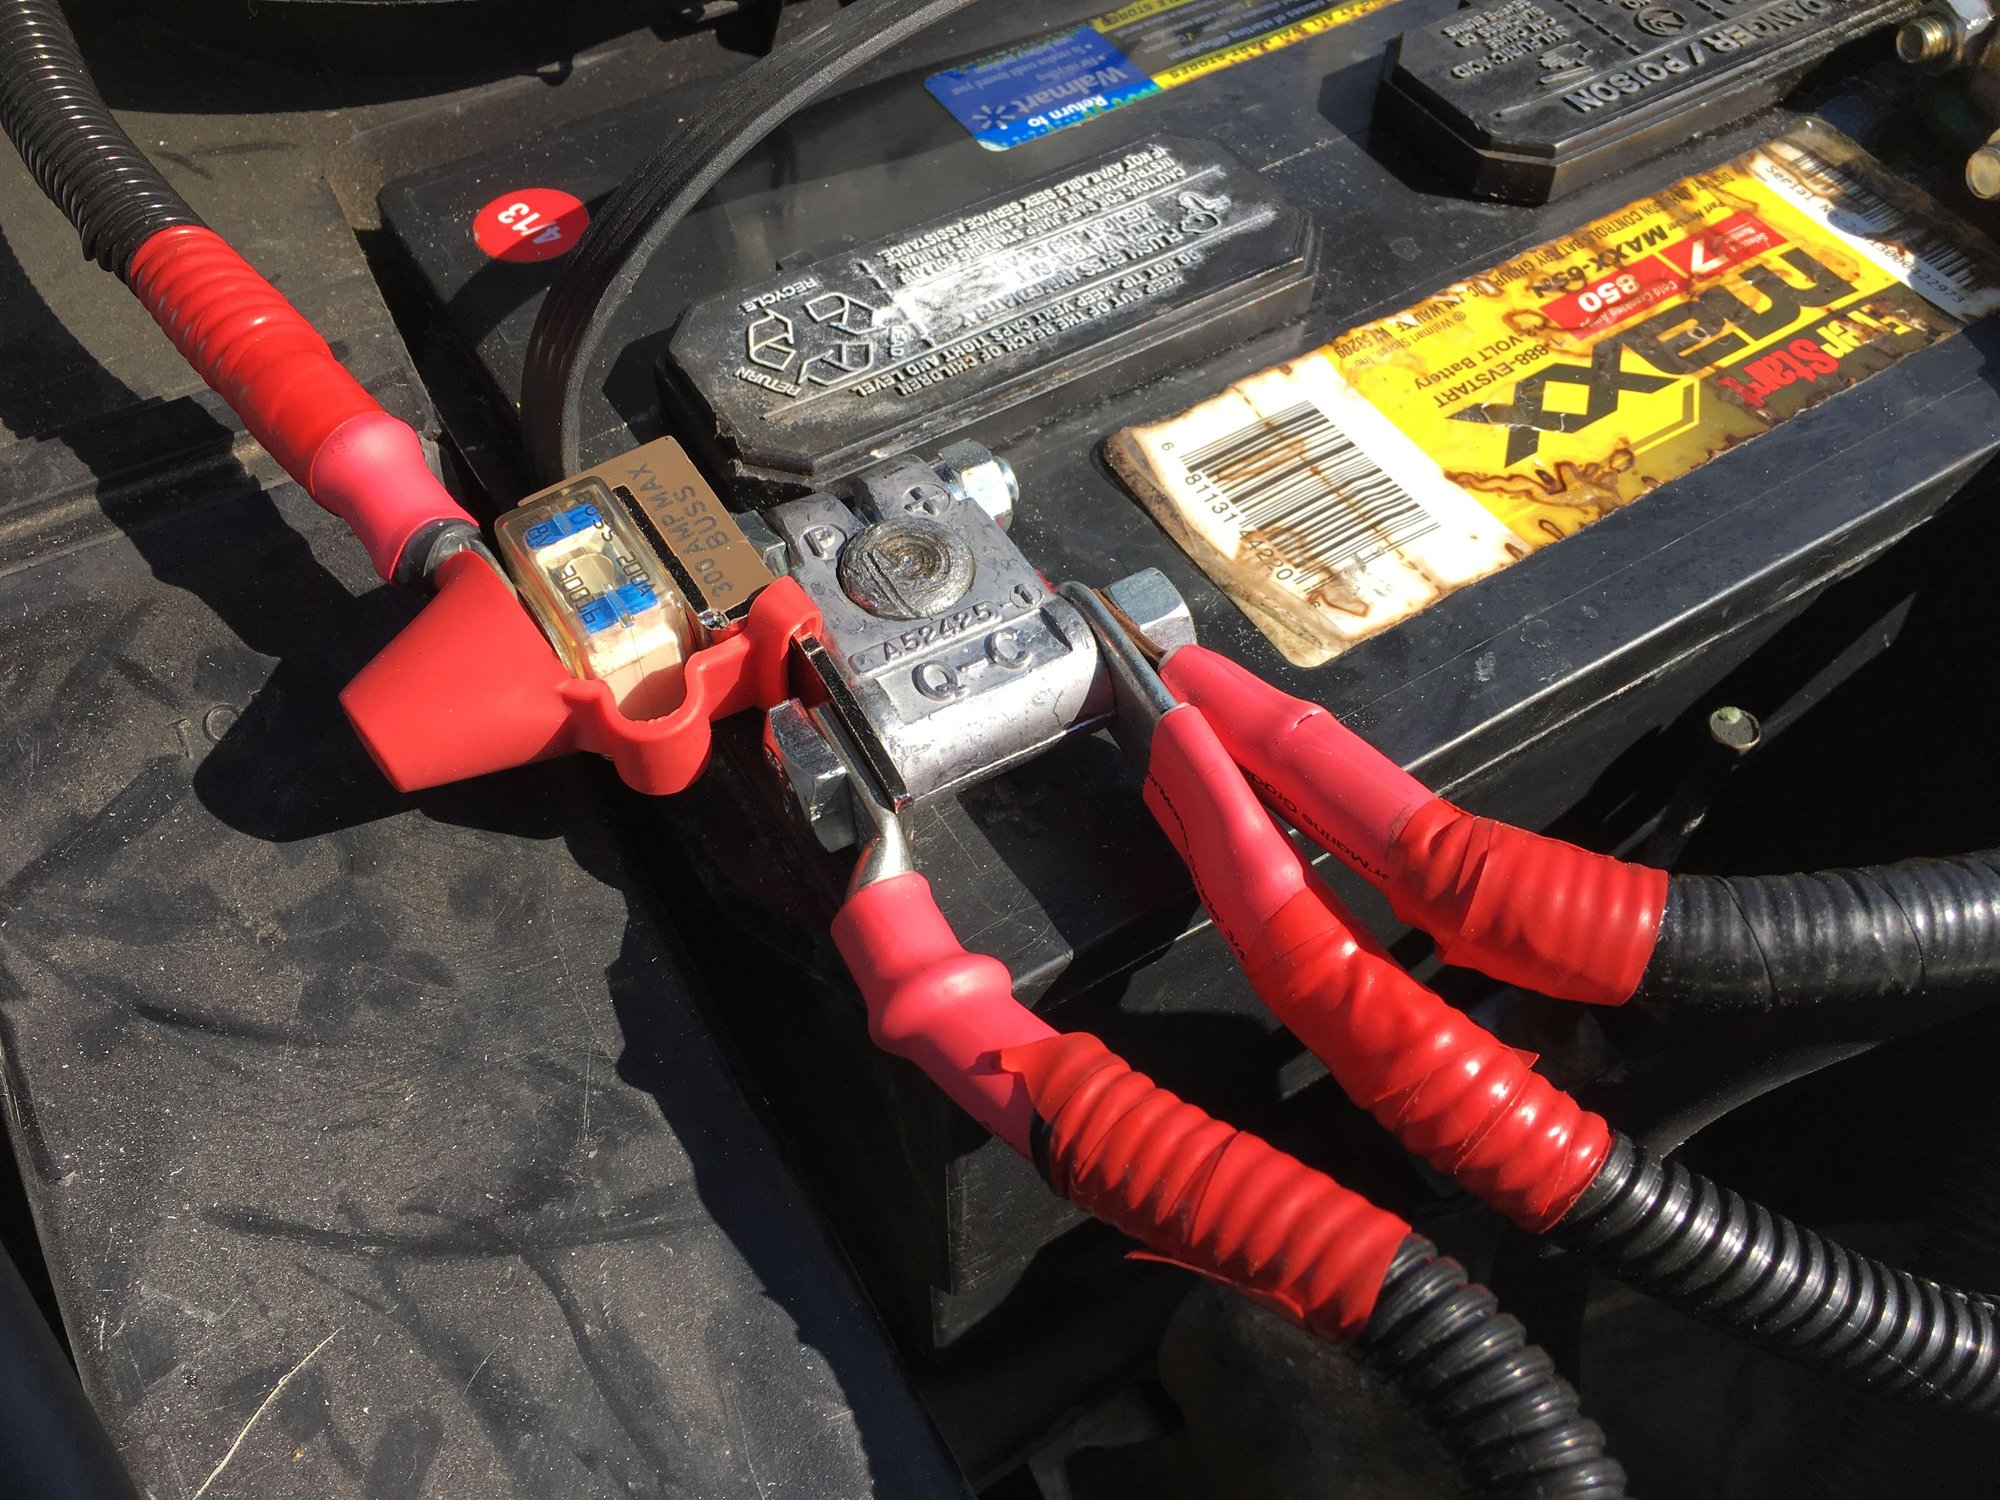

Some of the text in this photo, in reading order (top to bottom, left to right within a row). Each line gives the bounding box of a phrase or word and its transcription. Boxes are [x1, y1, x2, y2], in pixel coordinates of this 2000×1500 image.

[1168, 50, 1224, 81] STORES
[1009, 55, 1128, 124] Walmart
[1026, 89, 1108, 132] Return to
[1120, 147, 1151, 171] NOT
[1052, 157, 1123, 199] AVAILABLE
[1080, 151, 1174, 203] INSTRUCTIONS
[1764, 162, 1815, 202] Serial
[962, 196, 1022, 234] SERVICE
[1009, 193, 1066, 229] VEHICLE
[1018, 185, 1055, 212] SEEK
[1058, 197, 1097, 225] SAFE
[1065, 190, 1083, 206] IN
[1092, 187, 1124, 211] FOR
[1702, 198, 1723, 215] Part
[951, 216, 1009, 252] OWNERS
[1022, 210, 1062, 238] JUMP
[956, 224, 1022, 264] STARTING
[1126, 224, 1183, 260] FLUSH
[1533, 236, 1584, 268] BATTERY
[1680, 231, 1729, 278] 7
[897, 250, 957, 287] FOLLOW
[1145, 257, 1176, 279] NOT
[739, 273, 817, 317] RECYCLE
[1072, 282, 1113, 309] KEEP
[1575, 269, 1640, 316] 850
[1606, 288, 1653, 320] Cranking
[1651, 278, 1677, 298] Cold
[1033, 297, 1075, 325] VENT
[895, 269, 1183, 398] KEEP OUT OF THE REACH OF CHILDREN
[989, 314, 1031, 343] CAPS
[1409, 315, 1455, 344] Walmart
[939, 332, 989, 363] TIGHT
[1332, 331, 1373, 361] 53209
[732, 366, 801, 397] RETURN
[904, 353, 939, 377] AND
[1414, 356, 1477, 389] Battery
[1432, 336, 1564, 408] 1-888-EVSTART
[673, 485, 729, 550] BUSS
[1159, 437, 1176, 454] 6
[1183, 468, 1239, 528] 81131
[1235, 522, 1295, 585] 44220
[628, 463, 733, 597] 300 AMP MAX
[615, 548, 657, 599] 200A
[883, 602, 993, 661] A52425
